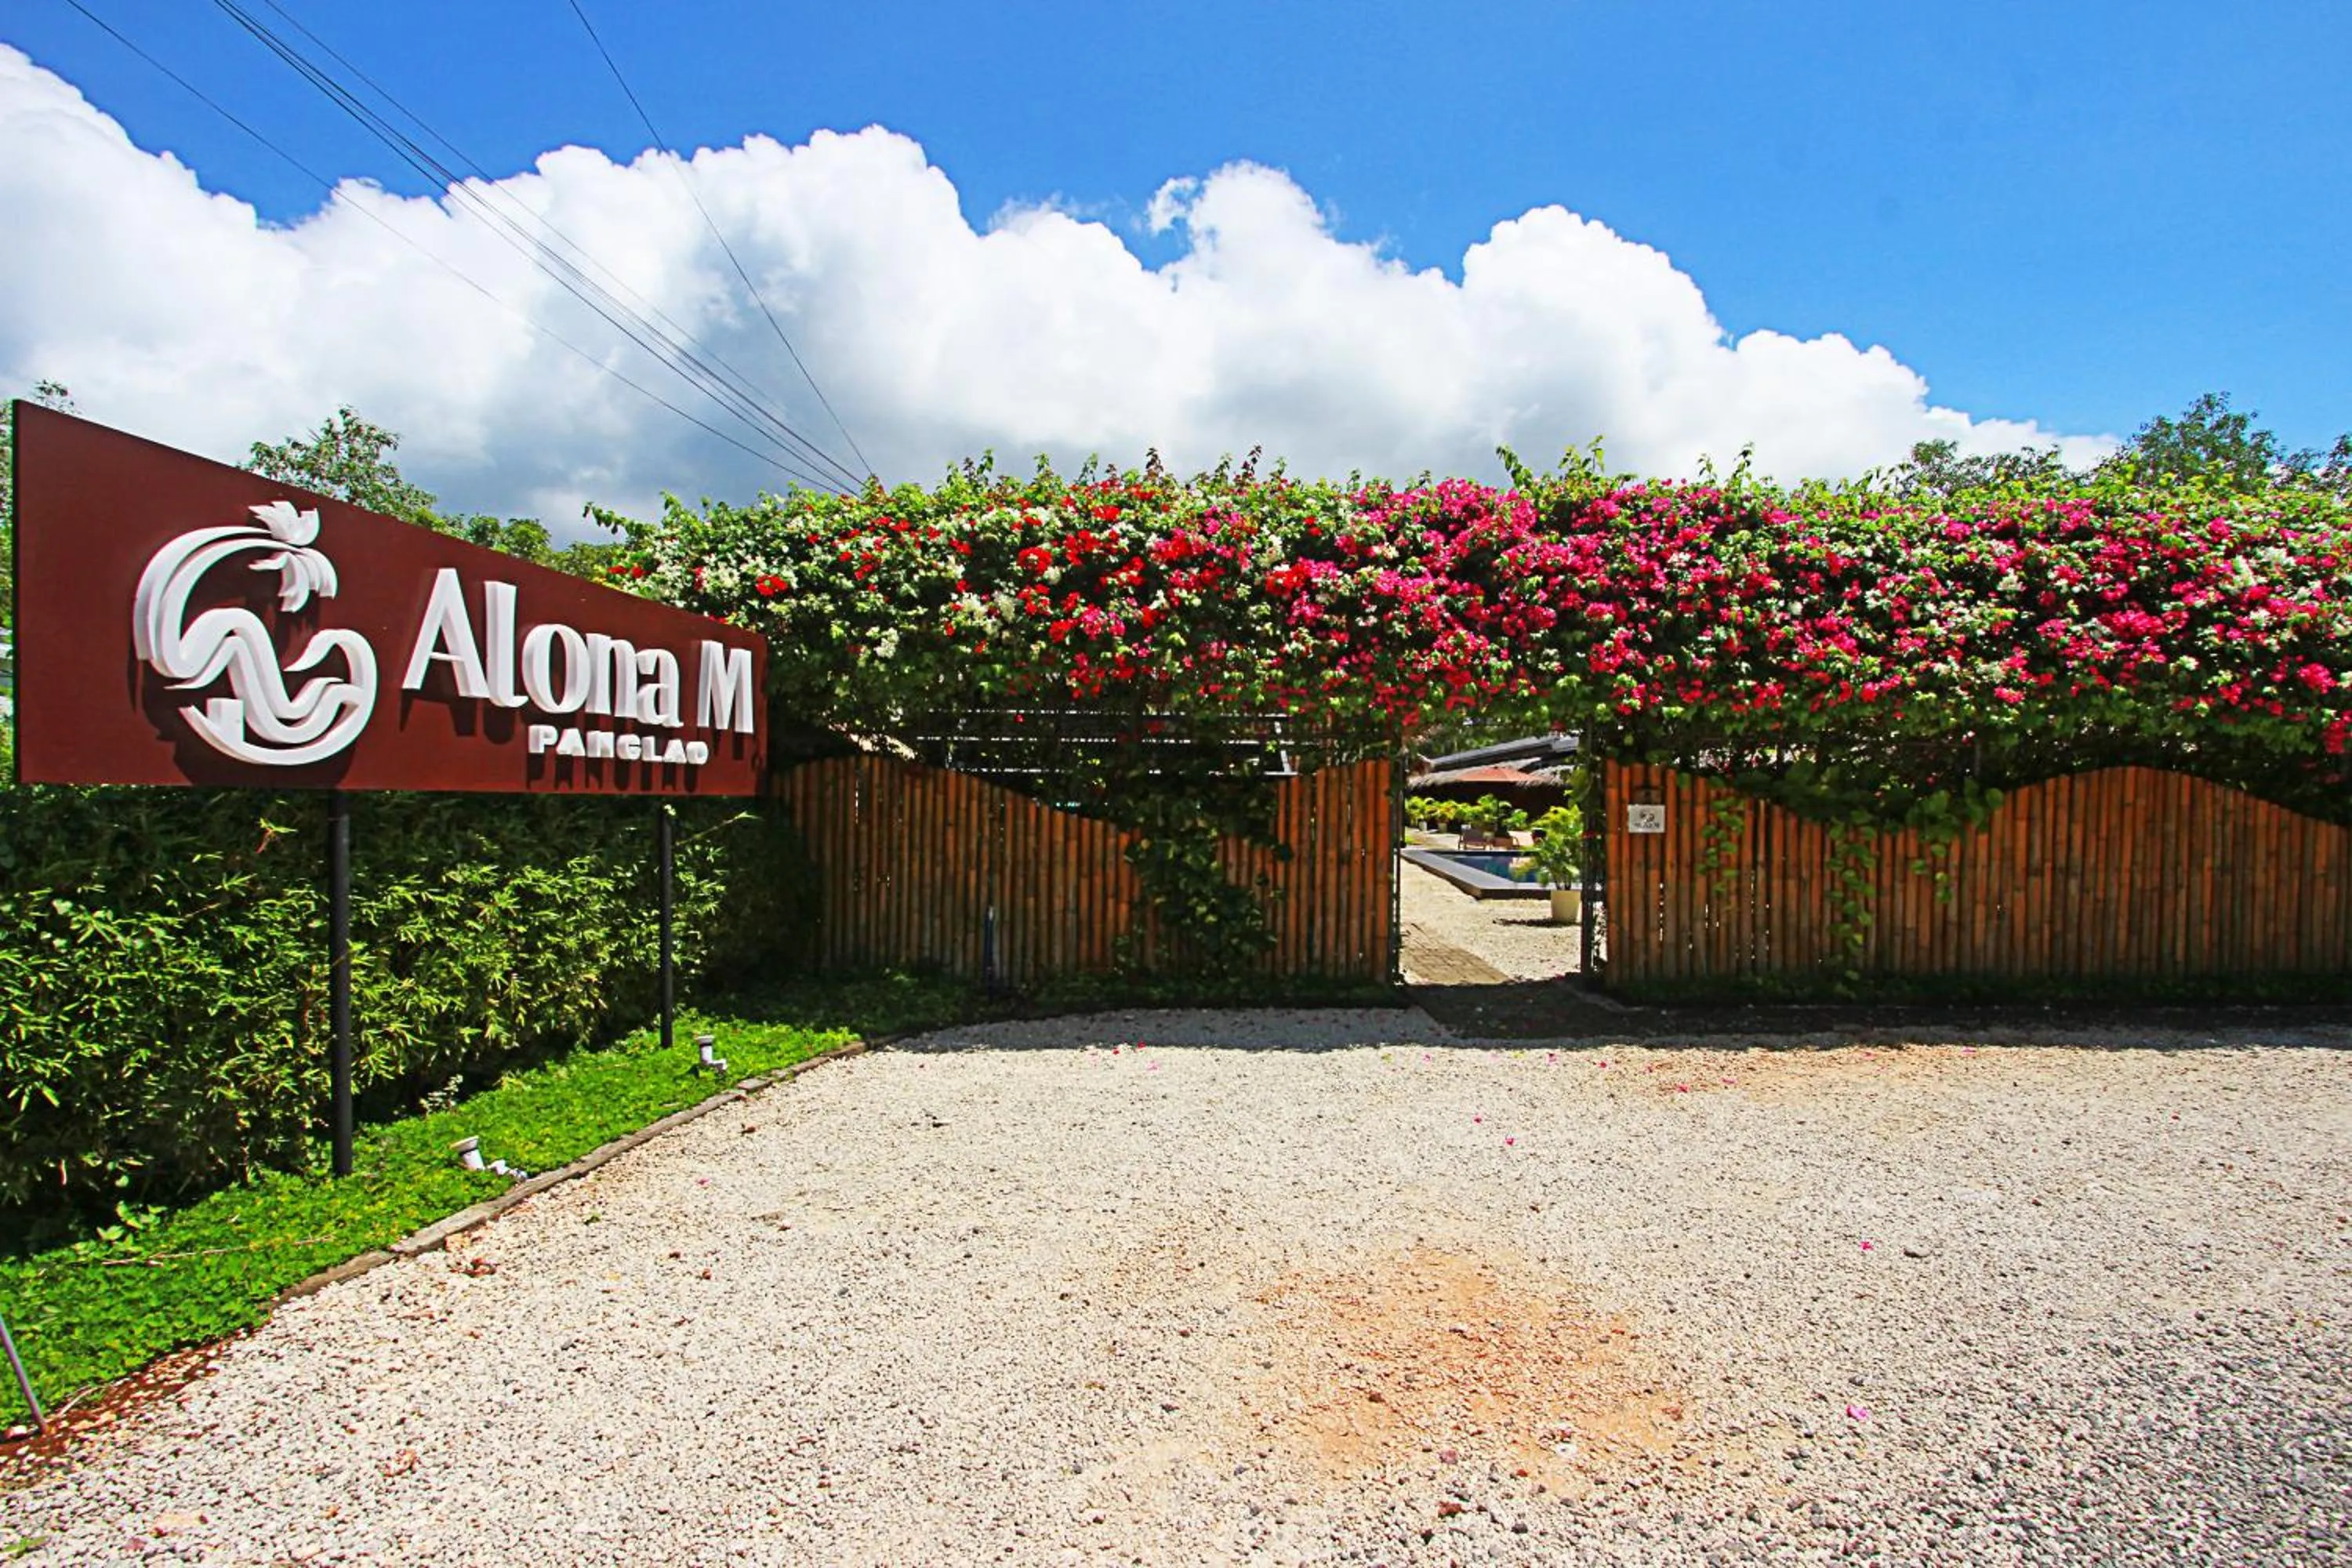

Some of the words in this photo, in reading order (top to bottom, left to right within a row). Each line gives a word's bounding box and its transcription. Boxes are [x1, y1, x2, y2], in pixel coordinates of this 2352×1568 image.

[402, 568, 684, 728] Alona
[697, 640, 754, 734] M
[528, 724, 709, 765] PANGLAO
